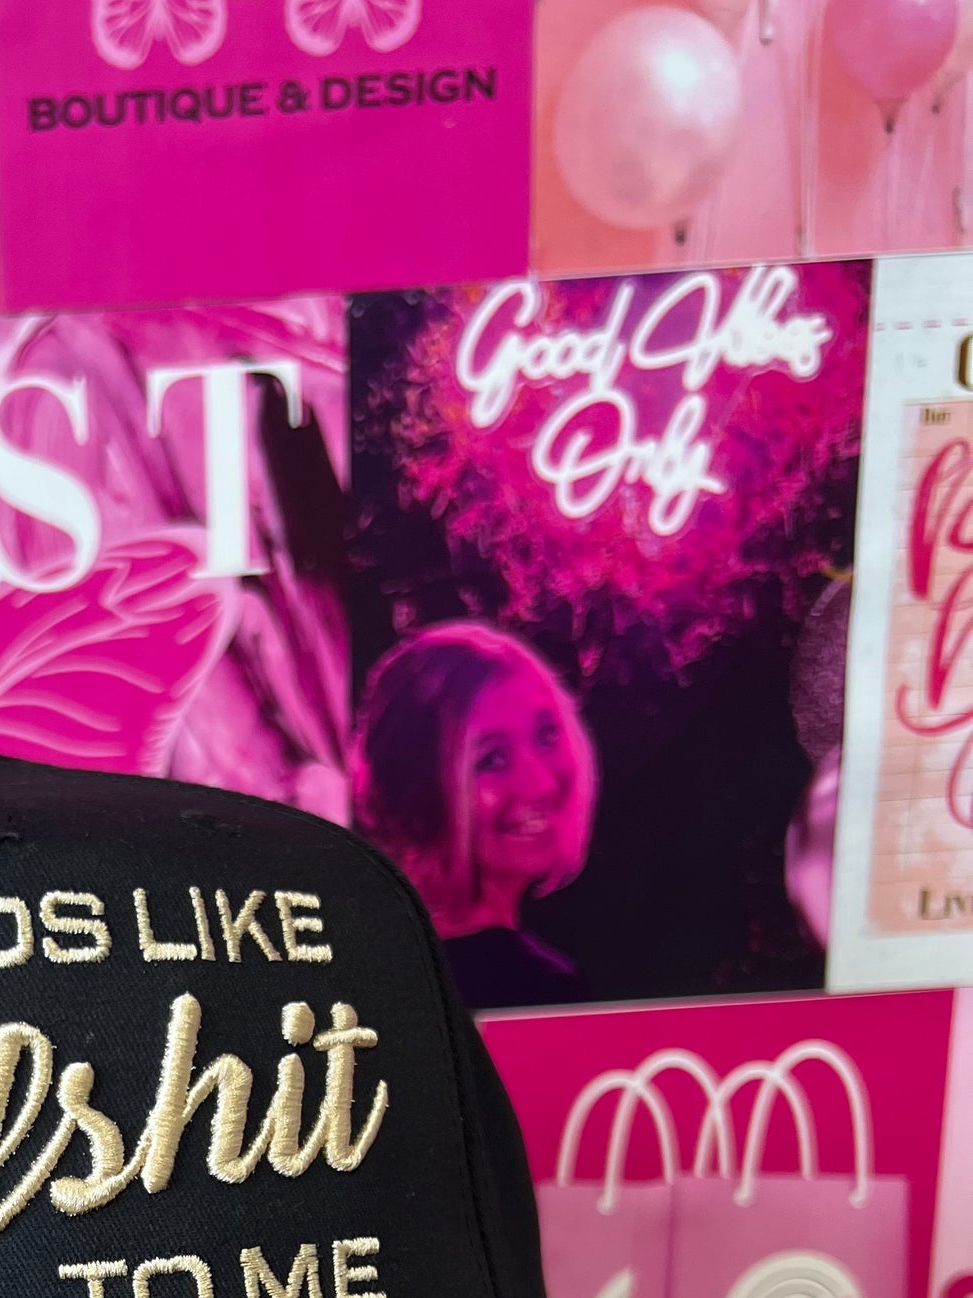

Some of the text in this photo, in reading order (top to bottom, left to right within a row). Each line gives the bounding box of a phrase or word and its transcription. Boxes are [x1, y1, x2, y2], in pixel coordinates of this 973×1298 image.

[28, 66, 497, 132] BOUTIQUE & DESIGN
[456, 264, 835, 428] Good Vibes
[532, 388, 727, 536] Only
[133, 886, 334, 964] LIKE
